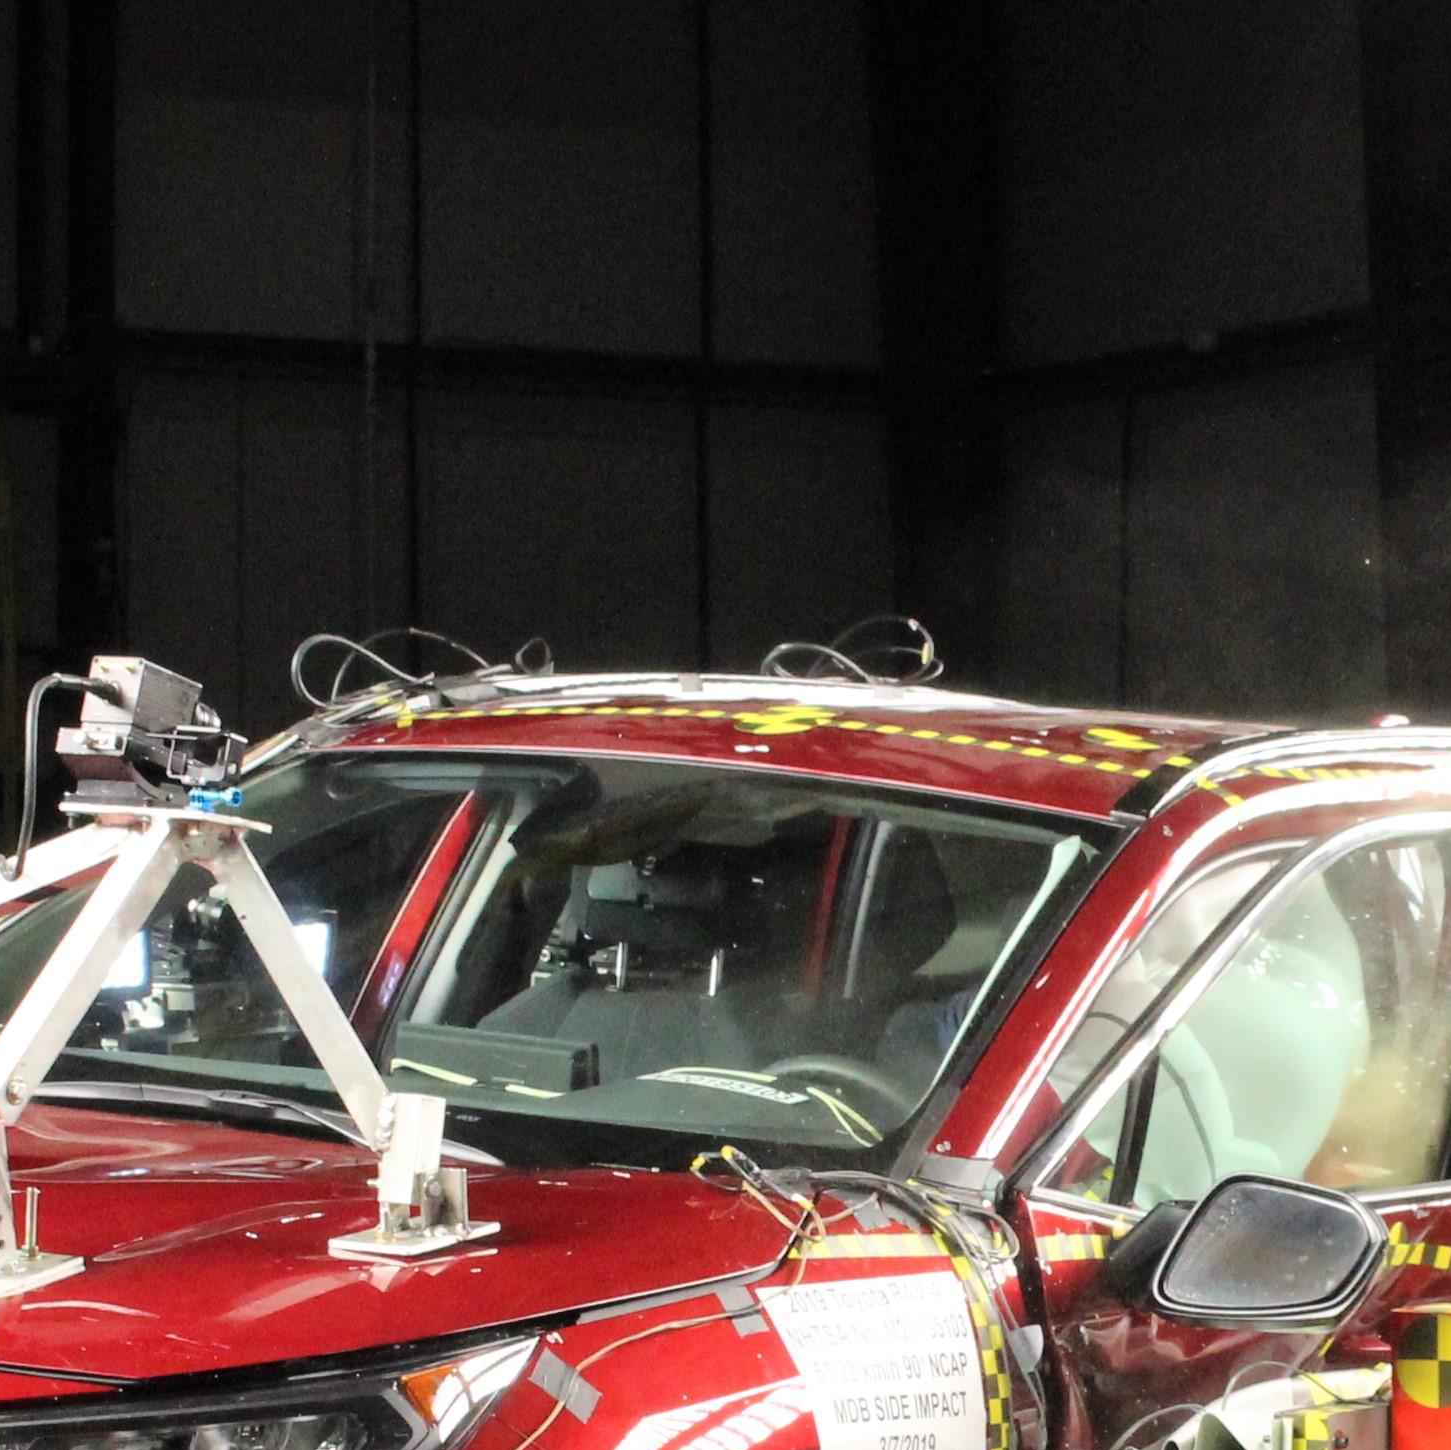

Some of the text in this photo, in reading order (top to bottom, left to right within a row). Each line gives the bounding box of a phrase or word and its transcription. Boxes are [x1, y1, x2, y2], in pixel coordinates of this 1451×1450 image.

[790, 1286, 828, 1313] 2019
[828, 1288, 890, 1313] Toyota
[785, 1324, 850, 1348] NHTSA
[852, 1323, 877, 1344] No
[861, 1357, 901, 1382] km/h
[928, 1351, 969, 1378] NCAP
[833, 1391, 968, 1424] MDB SIDE IMPACT
